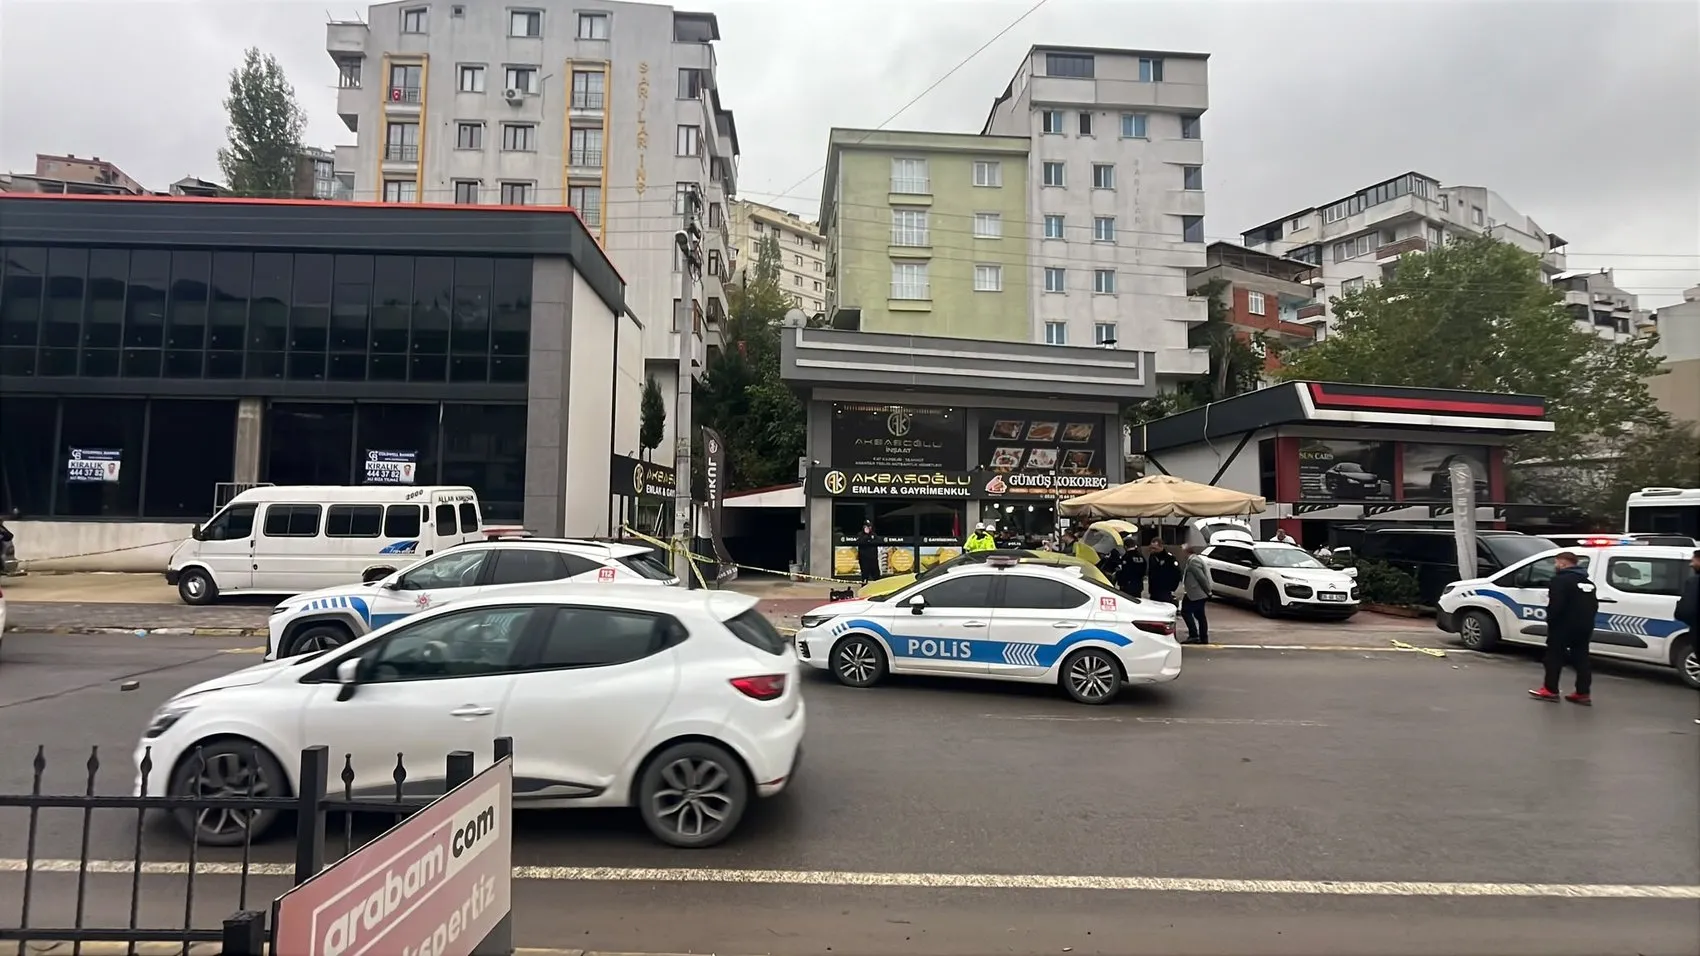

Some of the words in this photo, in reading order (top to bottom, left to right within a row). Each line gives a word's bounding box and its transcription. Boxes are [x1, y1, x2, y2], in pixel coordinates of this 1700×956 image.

[852, 472, 971, 486] AKBAŞOĞLU
[1008, 473, 1052, 488] GÜMÜŞ
[1053, 476, 1107, 489] KOKOREÇ
[646, 484, 662, 496] EMLAK
[852, 485, 888, 495] EMLAK
[890, 485, 898, 495] &
[900, 485, 971, 496] GAYRİMENKUL
[601, 569, 613, 578] 112
[1102, 598, 1114, 606] 112
[323, 843, 444, 956] arabam
[452, 805, 494, 858] com
